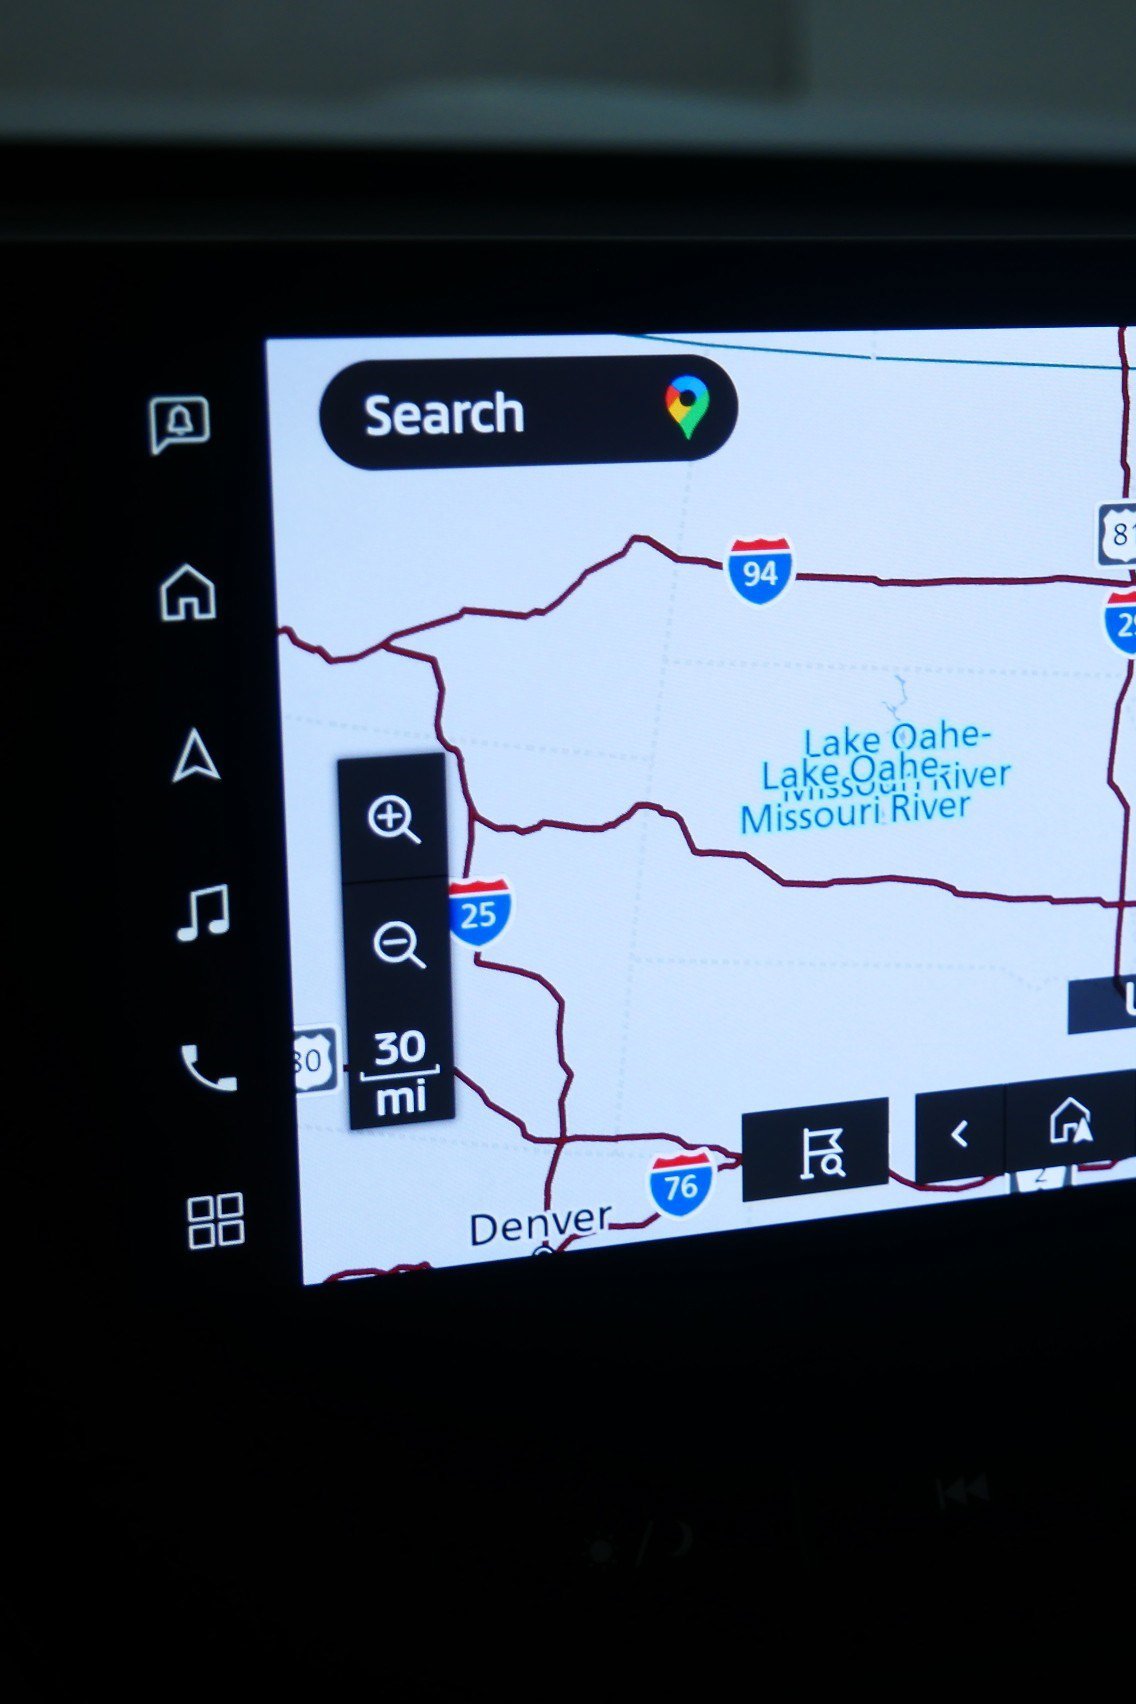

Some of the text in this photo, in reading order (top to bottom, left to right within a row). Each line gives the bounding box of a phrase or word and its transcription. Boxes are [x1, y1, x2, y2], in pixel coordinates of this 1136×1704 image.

[365, 391, 524, 436] Search
[742, 559, 778, 586] 94
[805, 719, 992, 758] Lake Oahe-
[763, 751, 951, 790] Lake Oahe-
[934, 761, 1011, 791] River
[741, 793, 971, 834] Missouri River
[460, 901, 496, 929] 25
[374, 1029, 426, 1066] 30
[377, 1077, 426, 1116] mi
[664, 1174, 698, 1201] 76
[470, 1204, 613, 1246] Denver
